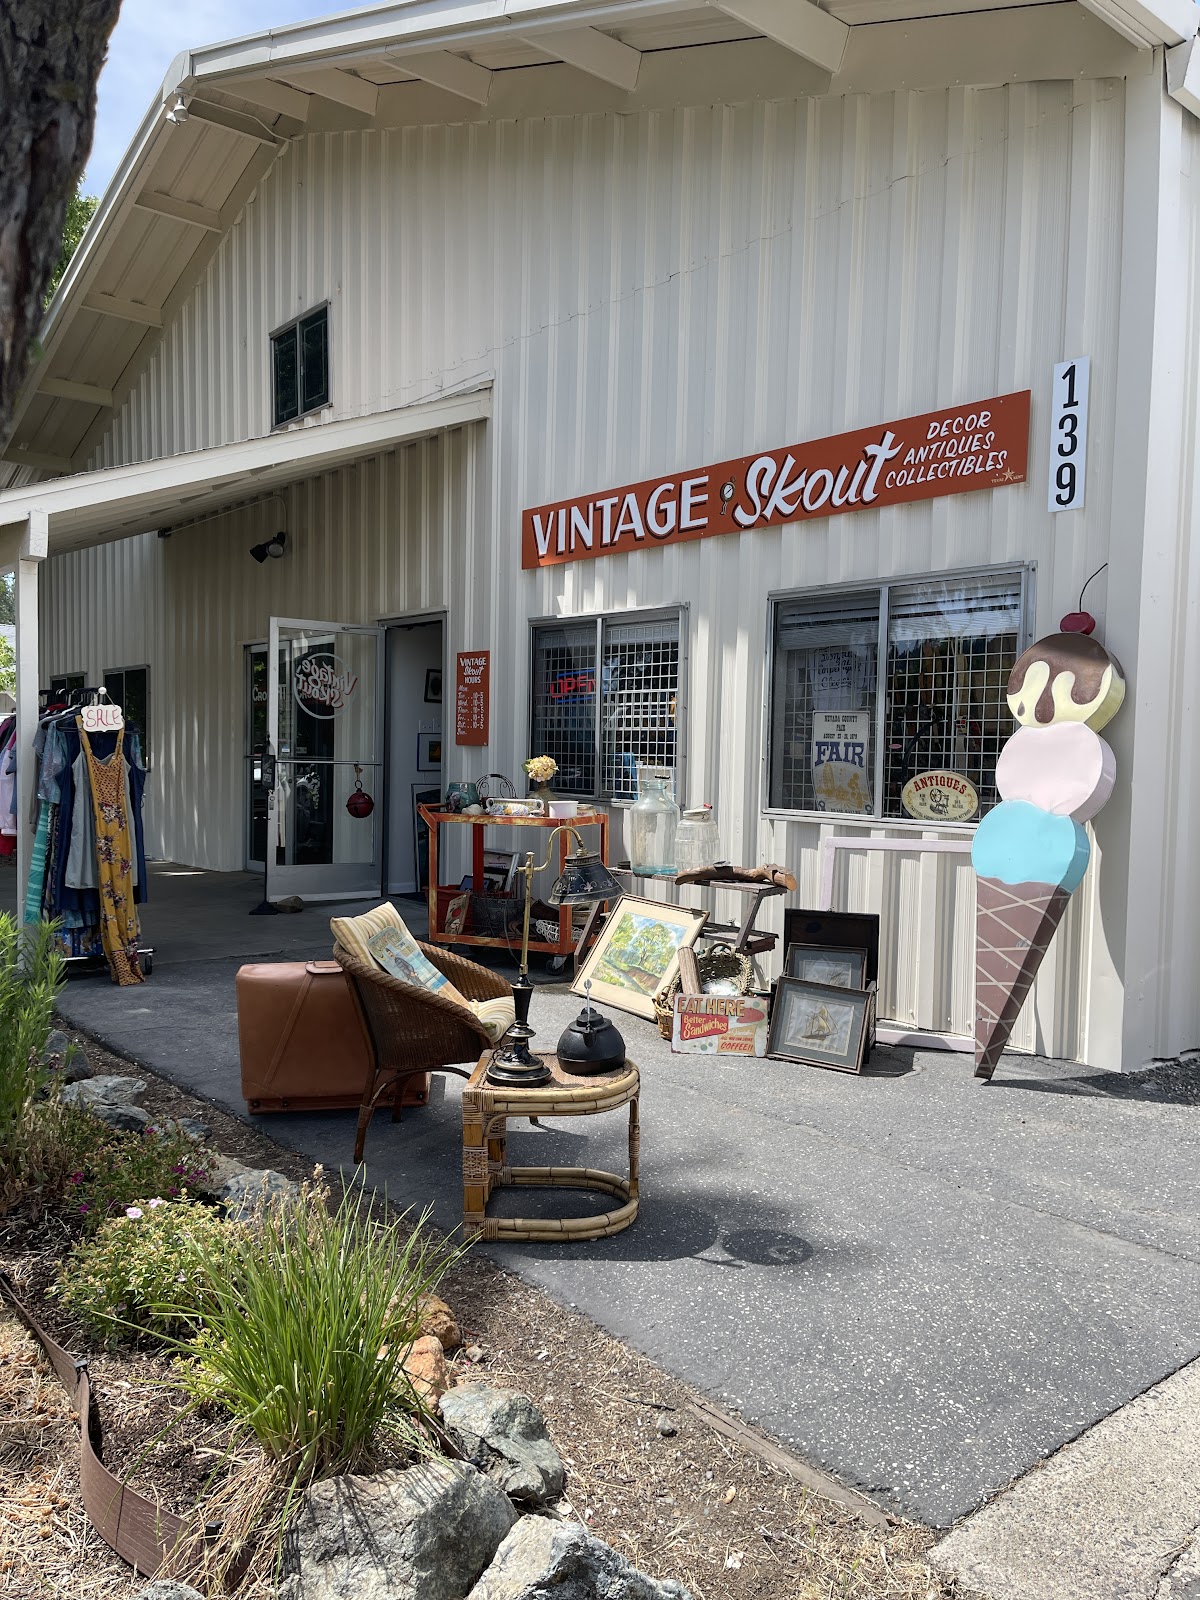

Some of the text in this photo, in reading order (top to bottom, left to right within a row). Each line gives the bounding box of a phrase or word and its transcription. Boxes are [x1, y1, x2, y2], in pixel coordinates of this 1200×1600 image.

[926, 411, 991, 440] DECOR
[1055, 364, 1078, 505] 139
[903, 431, 995, 465] ANTIQUES
[885, 450, 1007, 488] COLLECTIBLES
[531, 430, 905, 558] VINTAGE Skout
[460, 657, 487, 666] VINTAGE
[464, 676, 481, 684] HOURS
[85, 708, 121, 728] SALE
[815, 741, 865, 768] FAIR
[913, 775, 968, 795] ANTIQUES
[677, 997, 746, 1018] EAT HERE
[684, 1015, 706, 1024] Better
[684, 1018, 728, 1039] Sandwiches
